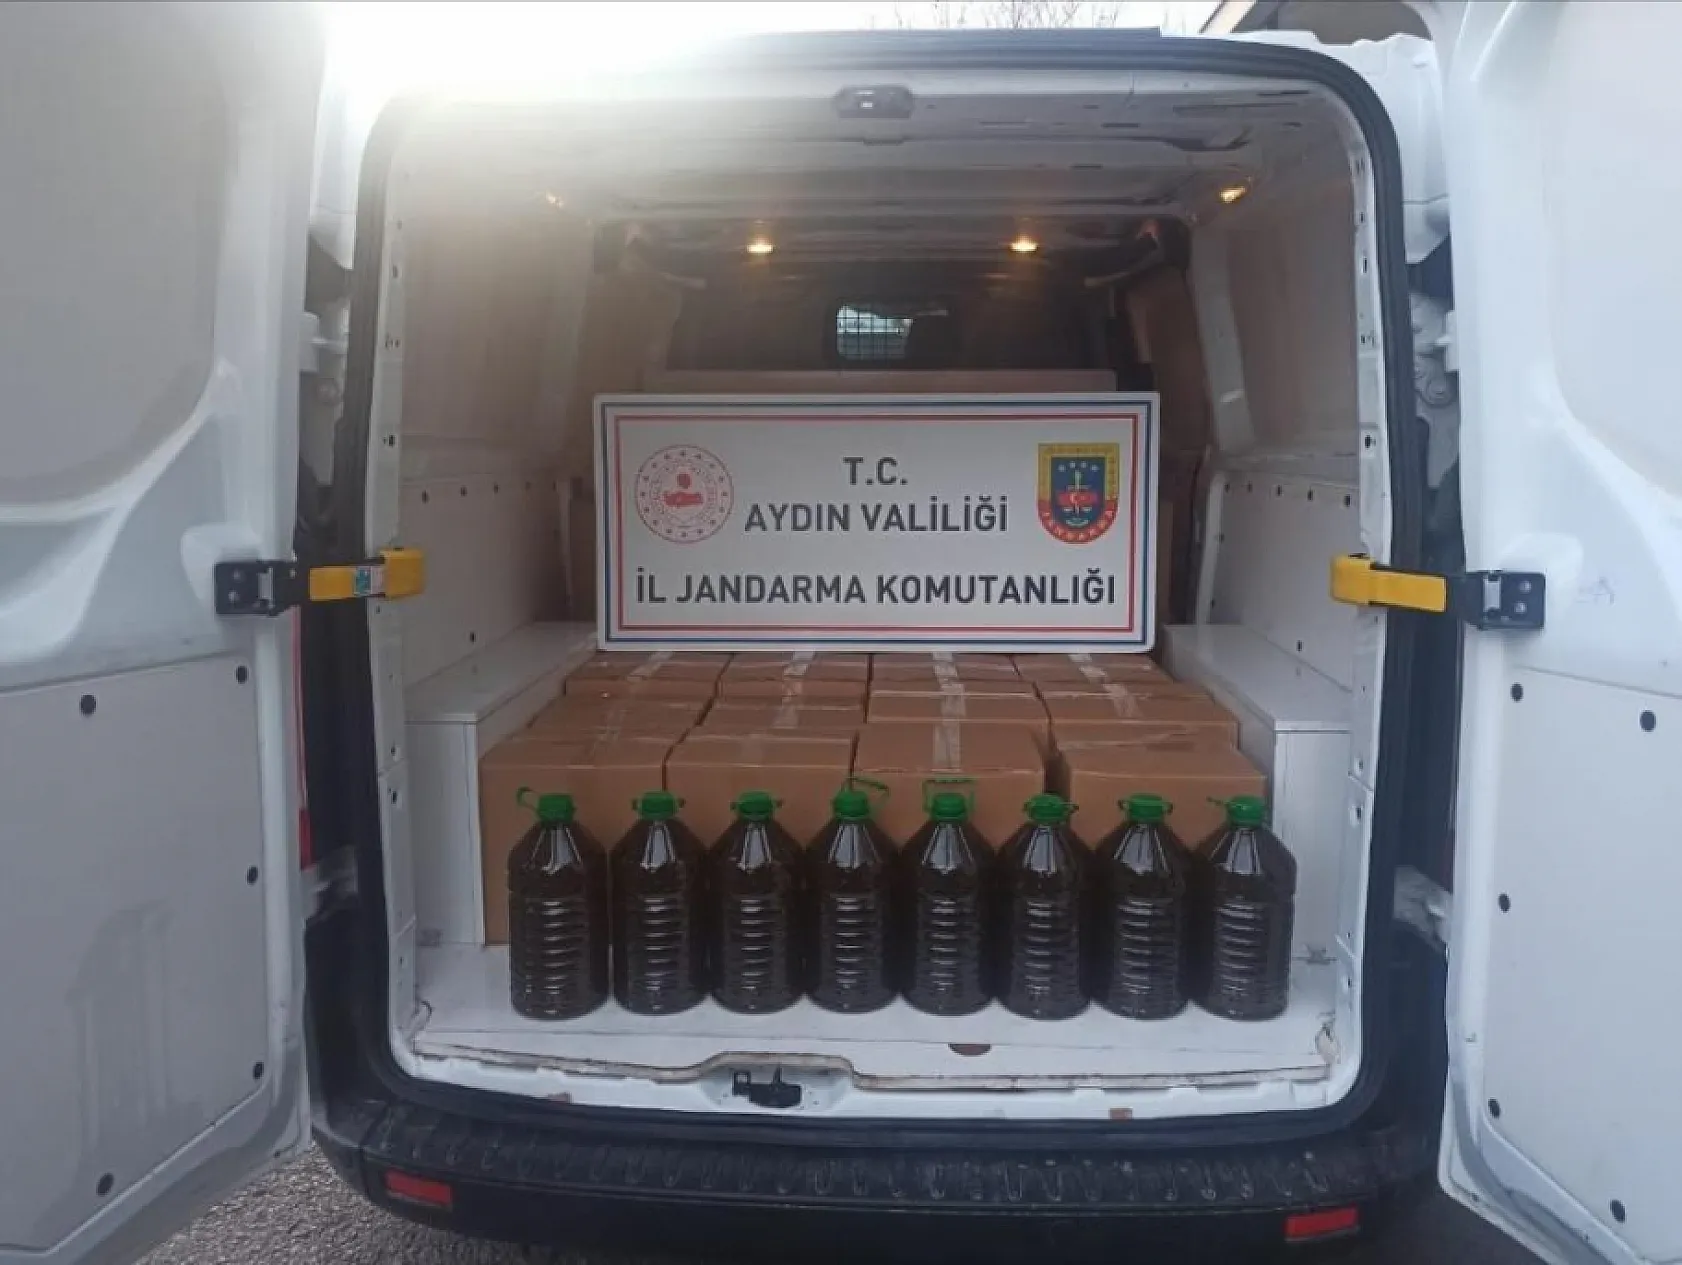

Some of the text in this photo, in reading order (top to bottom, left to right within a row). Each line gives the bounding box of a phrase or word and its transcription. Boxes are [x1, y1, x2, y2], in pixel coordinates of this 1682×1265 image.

[844, 457, 907, 485] T.C.
[745, 504, 849, 531] AYDIN
[861, 496, 1008, 531] VALİLİĞİ
[637, 566, 1115, 603] İL JANDARMA KOMUTANLIĞI
